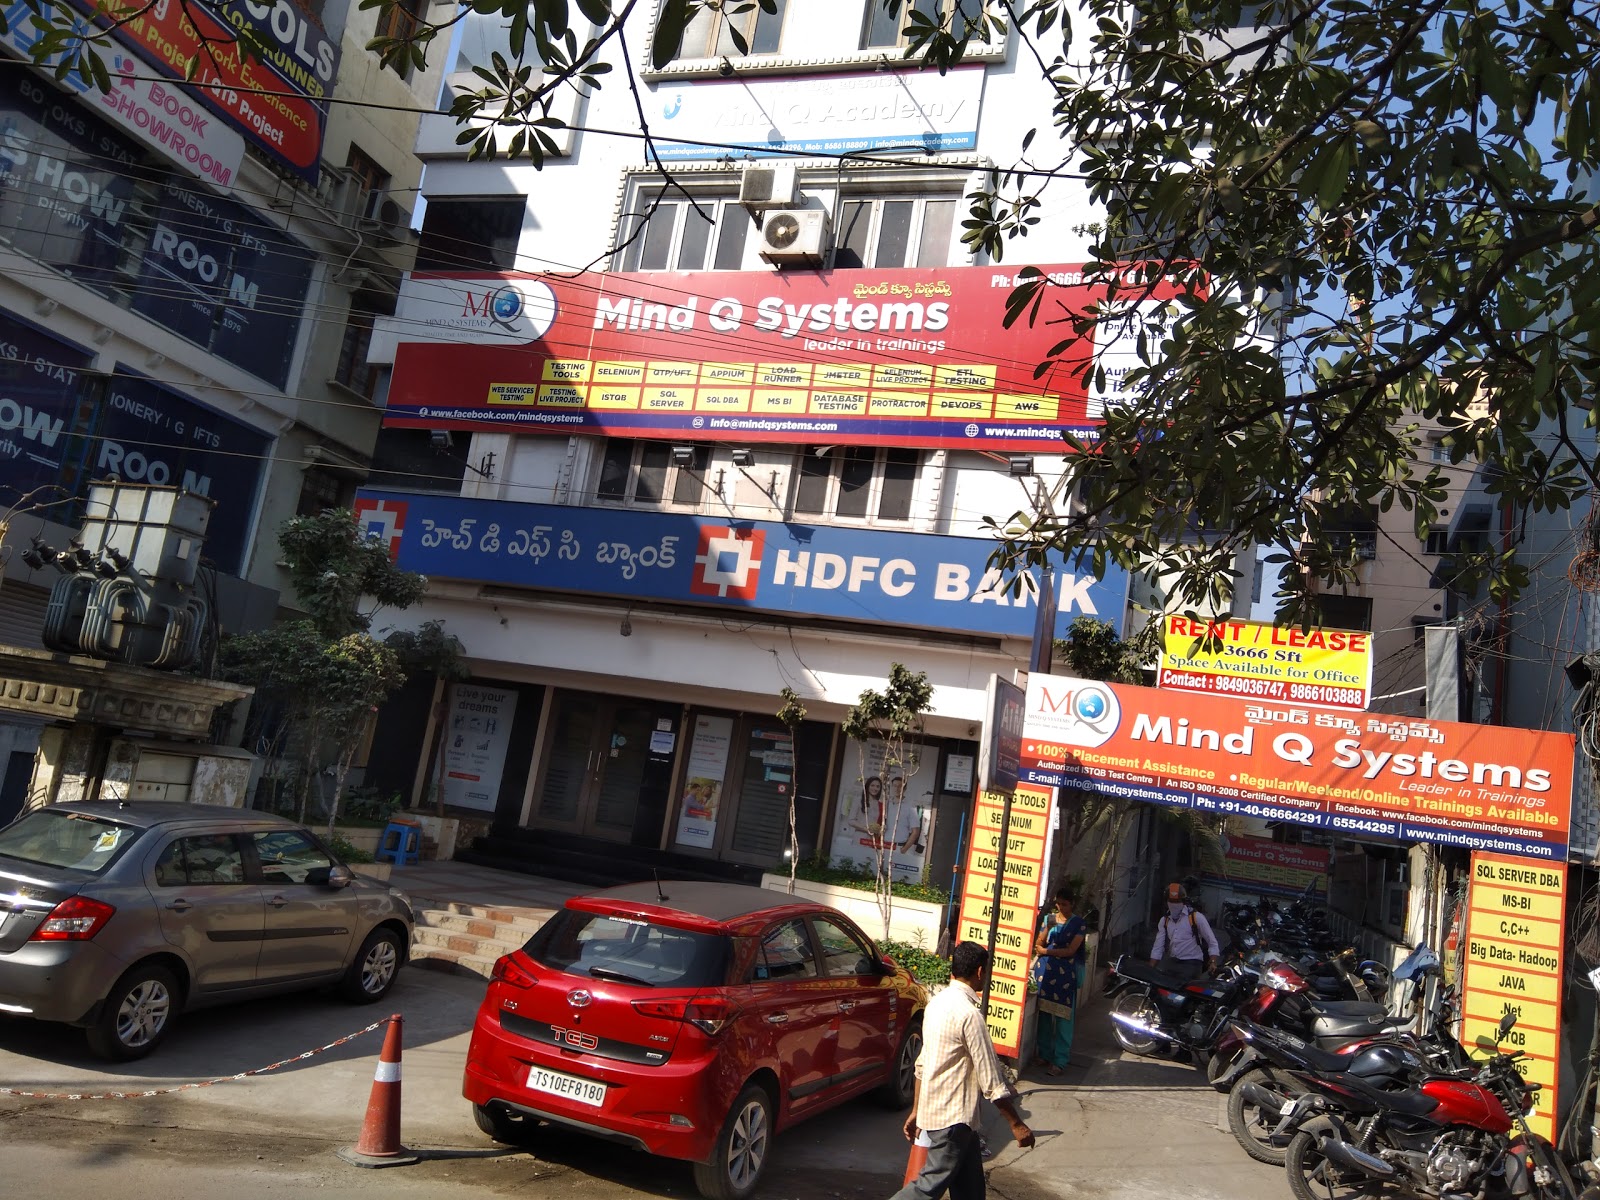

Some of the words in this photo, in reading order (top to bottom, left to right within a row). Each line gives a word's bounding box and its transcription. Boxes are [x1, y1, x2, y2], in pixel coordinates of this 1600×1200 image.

[205, 43, 237, 74] work
[240, 63, 307, 132] Experience
[148, 82, 209, 138] BOOK
[211, 78, 237, 106] QTP
[239, 99, 284, 146] Project
[101, 85, 232, 187] SHOWROOM
[804, 143, 823, 151] Mob:
[824, 140, 868, 150] 8686188809
[38, 196, 90, 232] priority
[991, 274, 1010, 288] Ph:
[192, 300, 212, 316] Since
[222, 318, 242, 333] 1979
[456, 319, 487, 327] SYSTEMS
[594, 297, 697, 332] Mind
[708, 297, 743, 333] Q
[752, 297, 950, 338] Systems
[804, 337, 851, 351] leader
[856, 337, 872, 351] in
[876, 338, 946, 354] trainings
[34, 357, 77, 386] STAT
[551, 363, 585, 371] TESTING
[553, 370, 580, 378] TOOLS
[598, 368, 640, 376] SELENIUM
[885, 368, 922, 376] SELENIUM
[956, 368, 975, 376] ETL
[944, 377, 987, 385] TESTING
[539, 395, 554, 403] LIVE
[555, 396, 584, 404] PROJECT
[660, 390, 677, 398] SQL
[814, 395, 864, 403] DATABASE
[110, 392, 163, 425] IONERY
[818, 403, 858, 411] TESTING
[872, 400, 926, 408] PROTRACTOR
[941, 401, 982, 409] DEVOPS
[431, 409, 584, 424] www.facebook.com/mindqsystems
[710, 418, 838, 431] info@mindqsystems.com
[773, 549, 916, 597] HDFC
[934, 562, 1099, 615] BANK
[1170, 616, 1246, 641] RENT
[1271, 626, 1367, 653] LEASE
[1224, 645, 1268, 660] 3666
[1274, 649, 1302, 663] Sft
[1169, 654, 1209, 669] Space
[1213, 658, 1281, 677] Available
[1287, 667, 1309, 679] for
[1313, 669, 1360, 684] Office
[456, 688, 479, 699] Live
[481, 691, 506, 704] your
[1163, 672, 1207, 689] Contact
[1215, 677, 1287, 700] 9849036747,
[1290, 683, 1362, 705] 9866103888
[458, 701, 498, 714] dreams
[1036, 744, 1069, 759] 100%
[1073, 749, 1140, 769] Placement
[1143, 759, 1215, 780] Assistance
[1130, 713, 1254, 756] Mind
[1273, 732, 1314, 767] Q
[1332, 739, 1552, 792] Systems
[1028, 771, 1061, 785] E-mail:
[1064, 777, 1188, 804] info@mindqsystems.com
[1037, 760, 1080, 773] Authorized
[1081, 765, 1107, 777] ISTQB
[1108, 770, 1125, 780] Test
[1126, 773, 1154, 784] Centre
[1166, 779, 1178, 787] An
[1180, 781, 1195, 790] ISO
[1197, 785, 1239, 797] 9001-2008
[1241, 789, 1277, 803] Certified
[1279, 796, 1321, 810] Company
[1399, 779, 1453, 796] Leader
[1458, 786, 1472, 798] in
[1477, 788, 1546, 808] Trainings
[1020, 794, 1046, 809] TOOLS
[1239, 773, 1409, 807] Regular/Weekend/Online
[1414, 796, 1483, 818] Trainings
[1487, 805, 1559, 826] Available
[1197, 797, 1215, 809] Ph:
[1219, 801, 1322, 824] +91-40-66664291
[1333, 817, 1396, 835] 65544295
[1335, 803, 1379, 816] facebook:
[1382, 811, 1543, 838] www.facebook.com/mindqsystems
[1406, 828, 1552, 856] www.mindqsystems.com
[1232, 847, 1262, 858] Mind
[1265, 852, 1274, 861] Q
[1279, 854, 1325, 868] Systems
[1477, 864, 1495, 878] SQL
[1498, 867, 1537, 884] SERVER
[1540, 873, 1560, 888] DBA
[1502, 894, 1531, 909] MS-BI
[969, 927, 984, 940] ETL
[1500, 921, 1530, 937] C,C++
[1470, 942, 1486, 959] Big
[1519, 950, 1558, 970] Hadoop
[1499, 974, 1526, 990] JAVA
[535, 1071, 604, 1101] TS10EF8180
